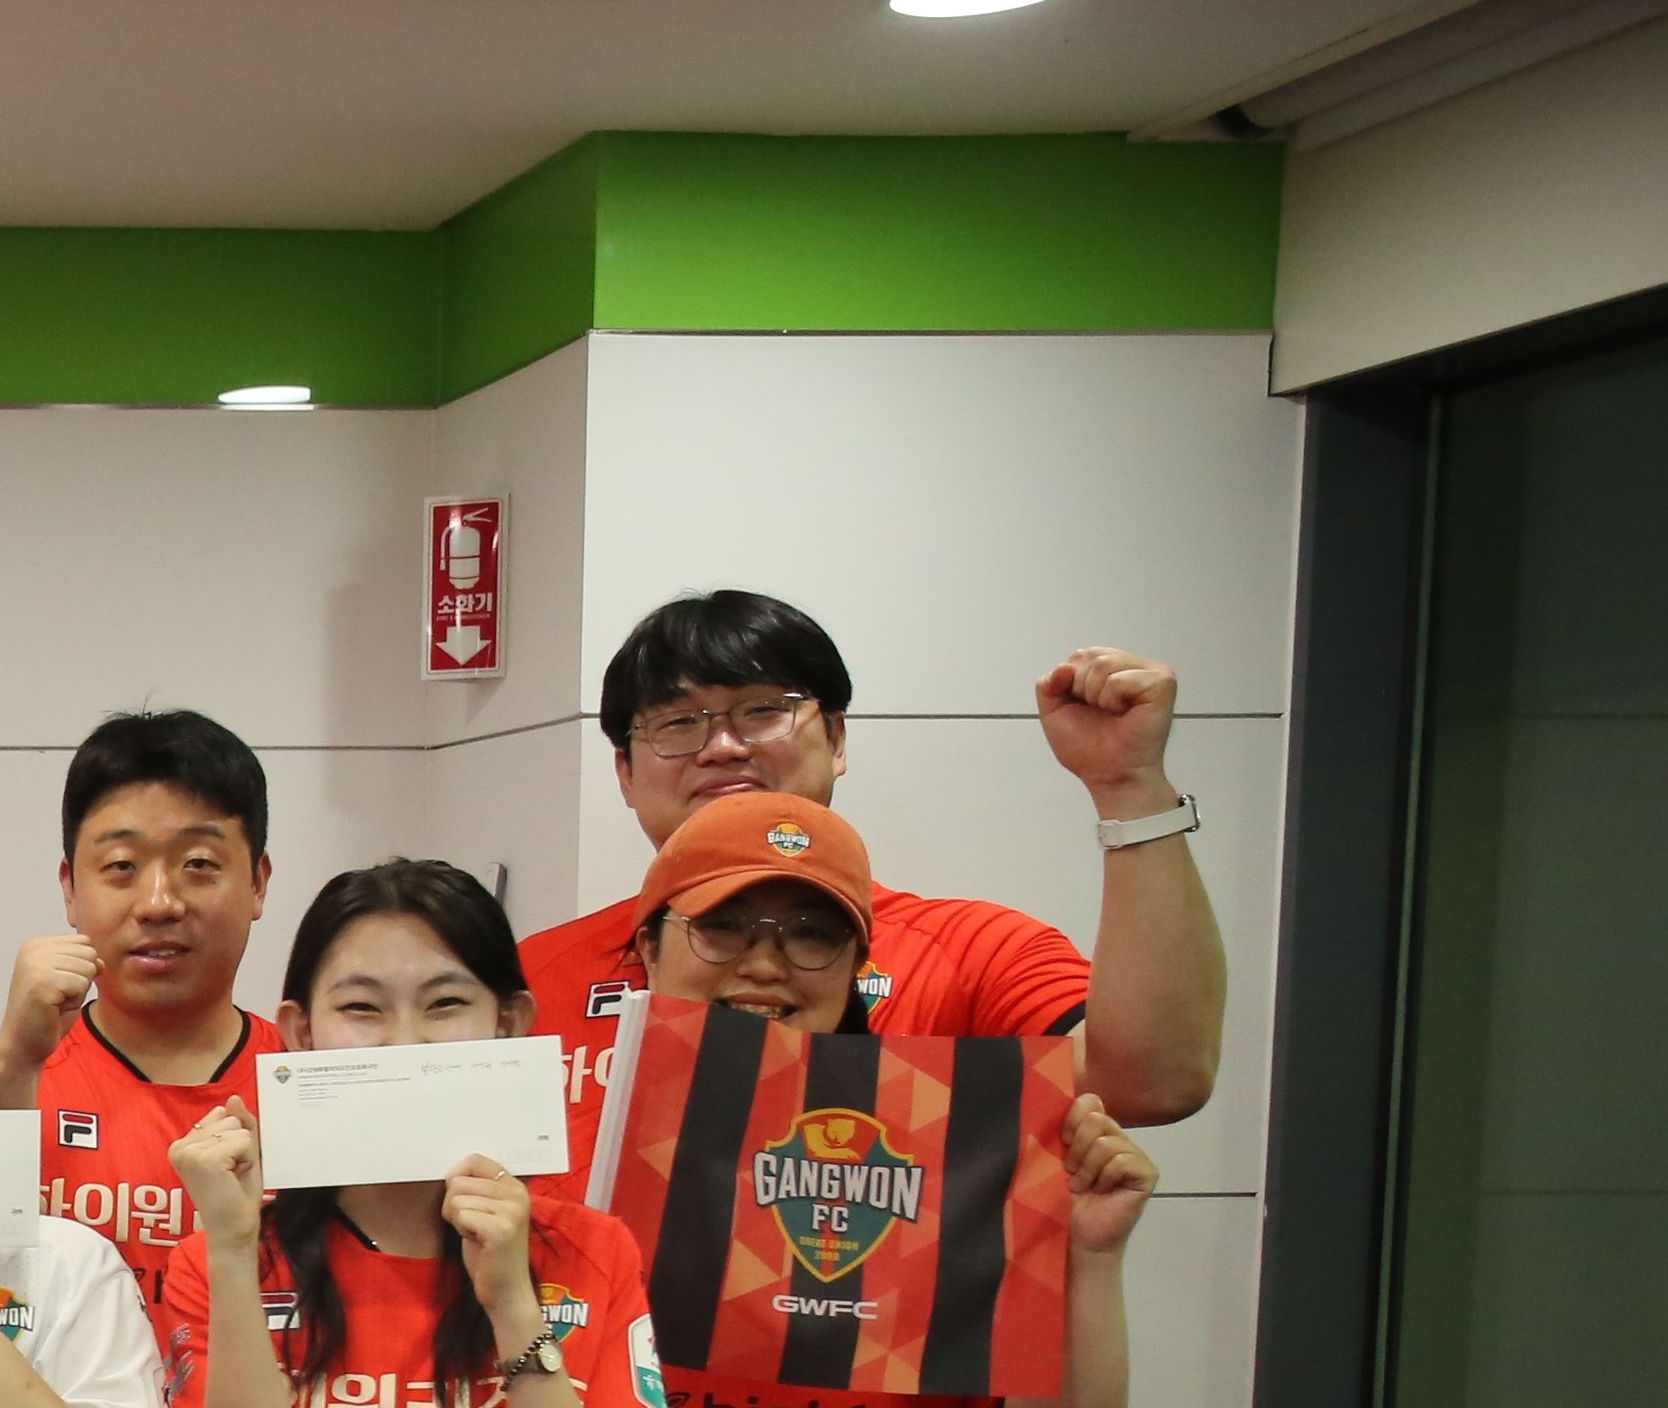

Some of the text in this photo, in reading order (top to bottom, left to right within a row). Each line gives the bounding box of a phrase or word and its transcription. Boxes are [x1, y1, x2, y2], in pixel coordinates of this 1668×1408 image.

[437, 592, 492, 614] 소화기
[753, 1150, 924, 1222] GANGWON
[811, 1203, 849, 1233] FC
[772, 1294, 879, 1321] GWFC
